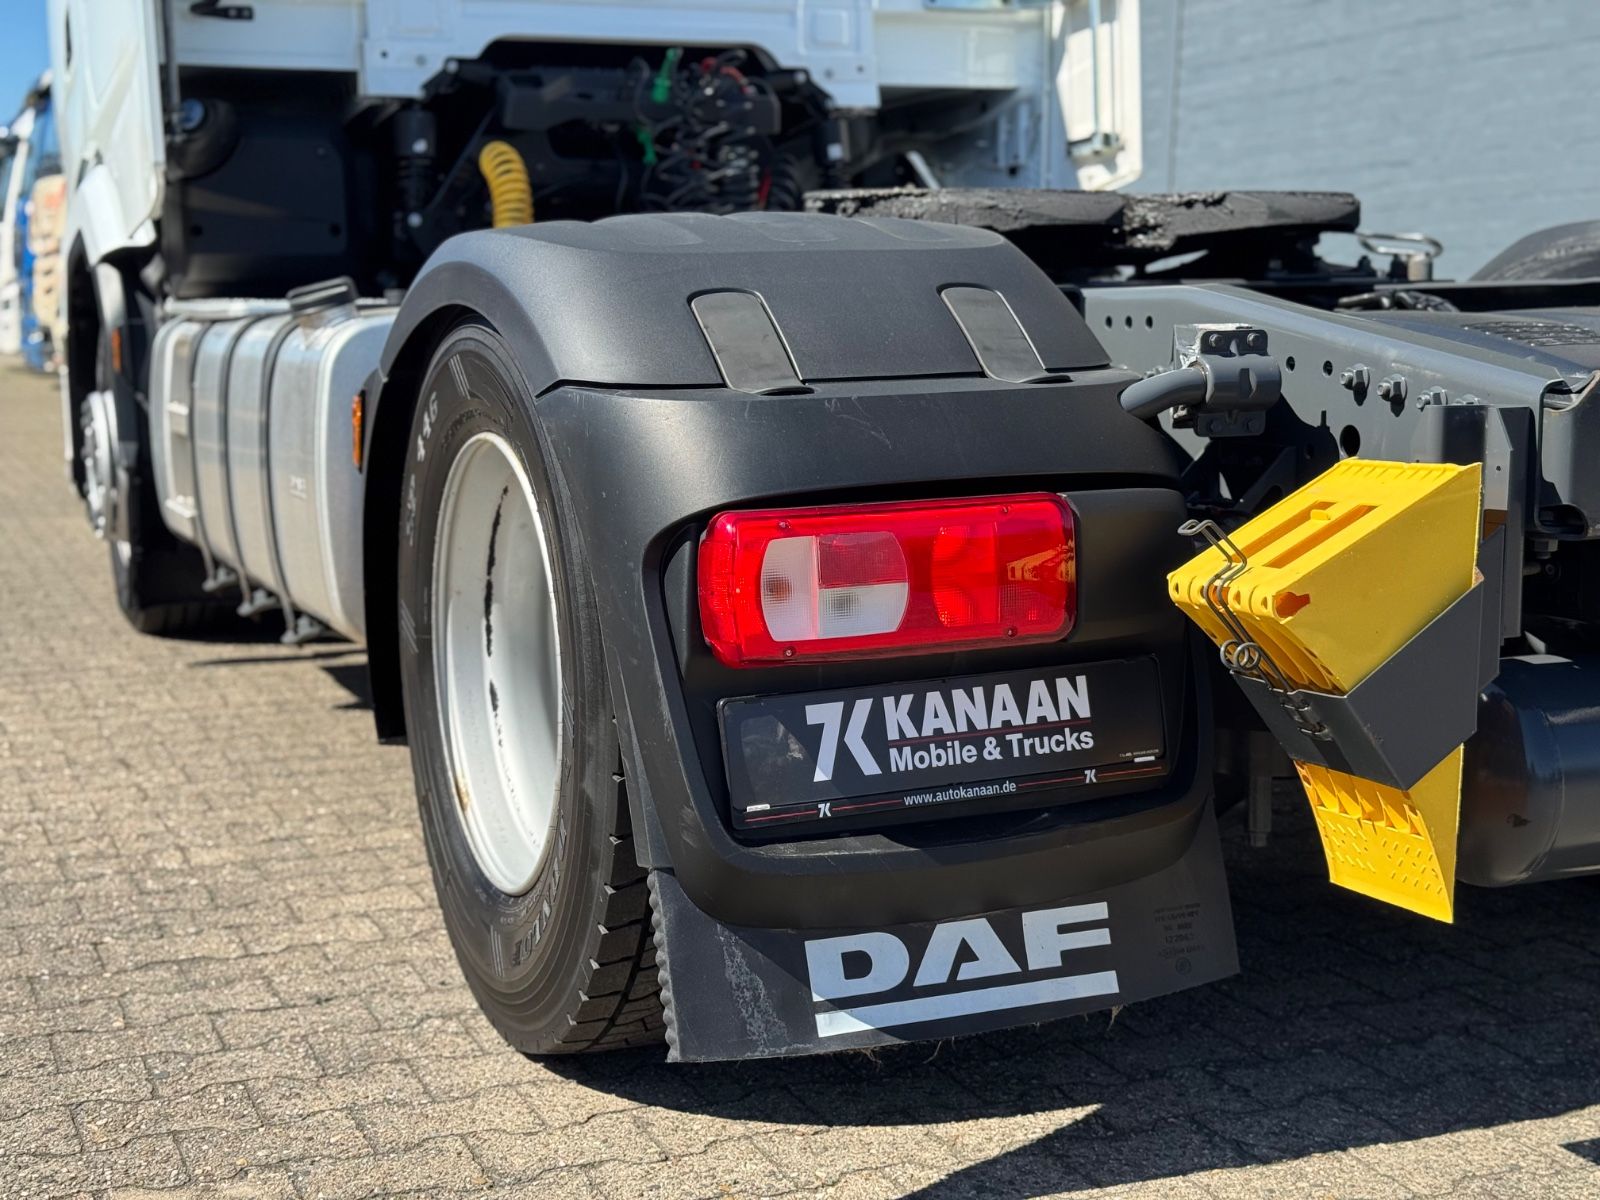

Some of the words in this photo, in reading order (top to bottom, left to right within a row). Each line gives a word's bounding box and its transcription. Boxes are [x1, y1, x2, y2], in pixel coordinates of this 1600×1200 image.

[882, 675, 1091, 740] KANAAN
[889, 740, 978, 773] Mobile
[983, 737, 1003, 760] &
[1005, 727, 1094, 758] Trucks
[904, 780, 1016, 806] www.autokanaan.de
[804, 902, 1112, 1002] DAF
